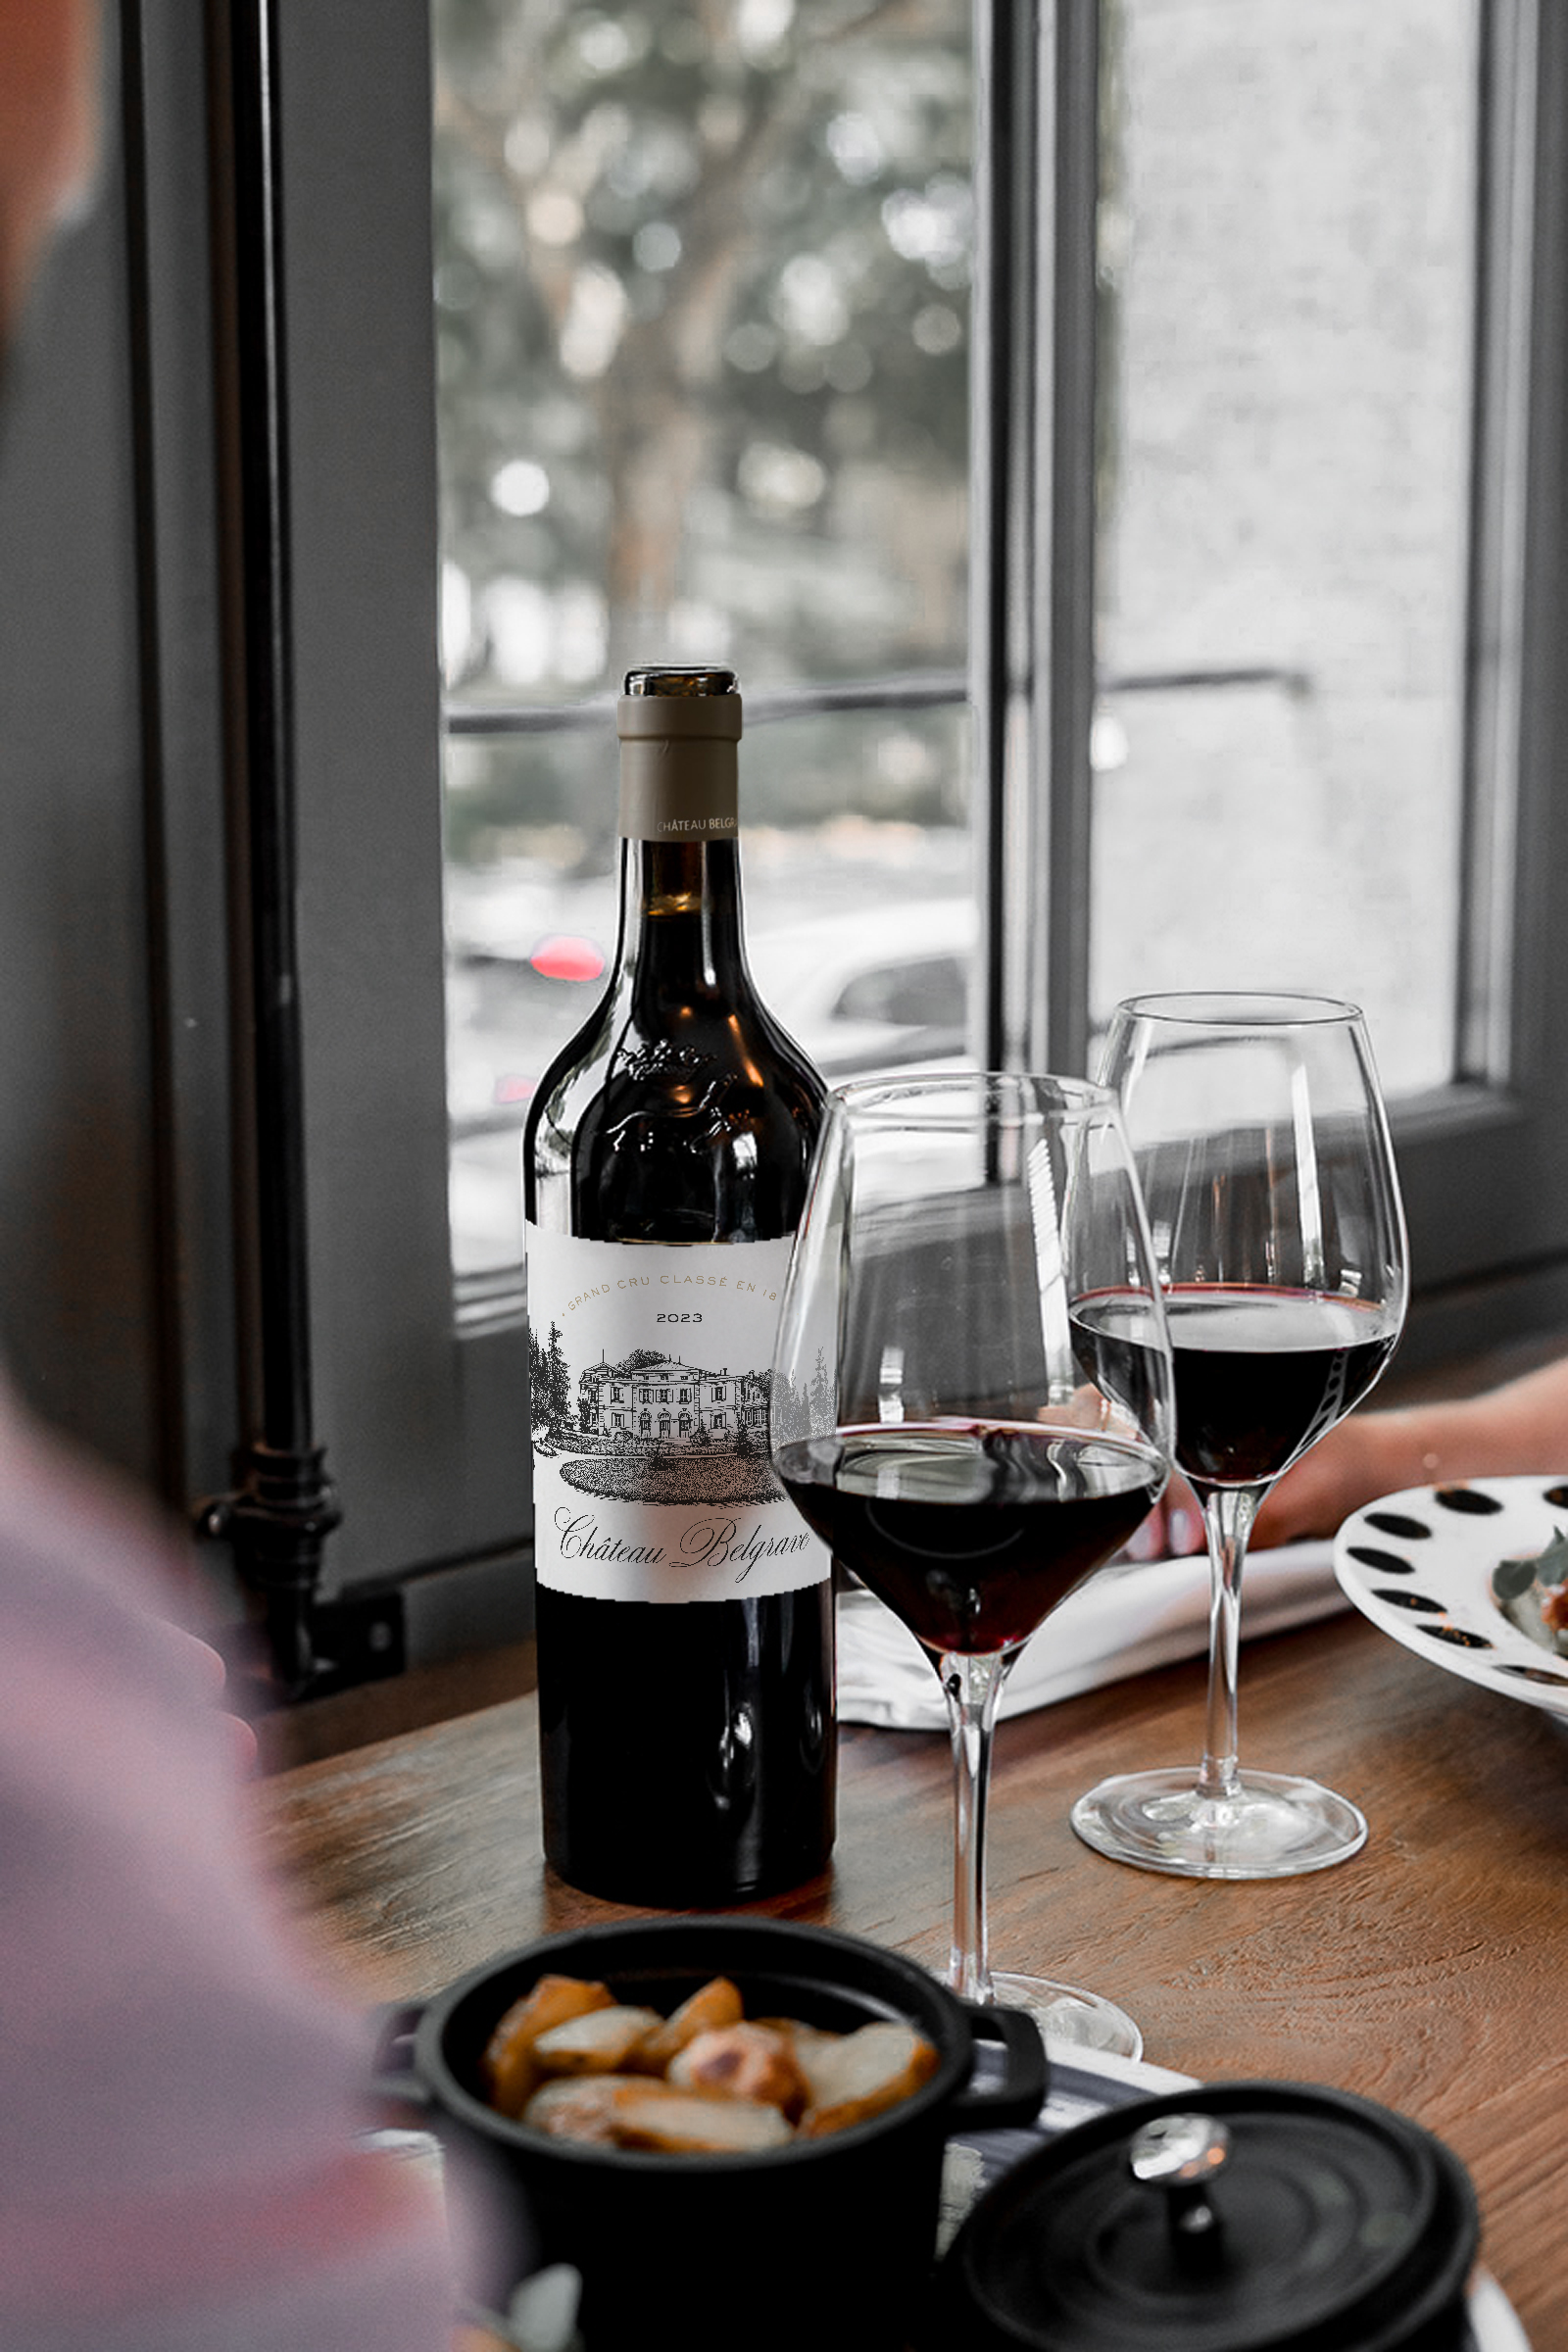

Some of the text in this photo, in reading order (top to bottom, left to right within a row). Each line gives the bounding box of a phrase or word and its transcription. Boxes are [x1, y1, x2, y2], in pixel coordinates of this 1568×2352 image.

[567, 1274, 777, 1311] GRAND CRU CLASSÉ EN 18
[656, 1312, 703, 1323] 2023
[554, 1506, 810, 1584] Château Belgrave
